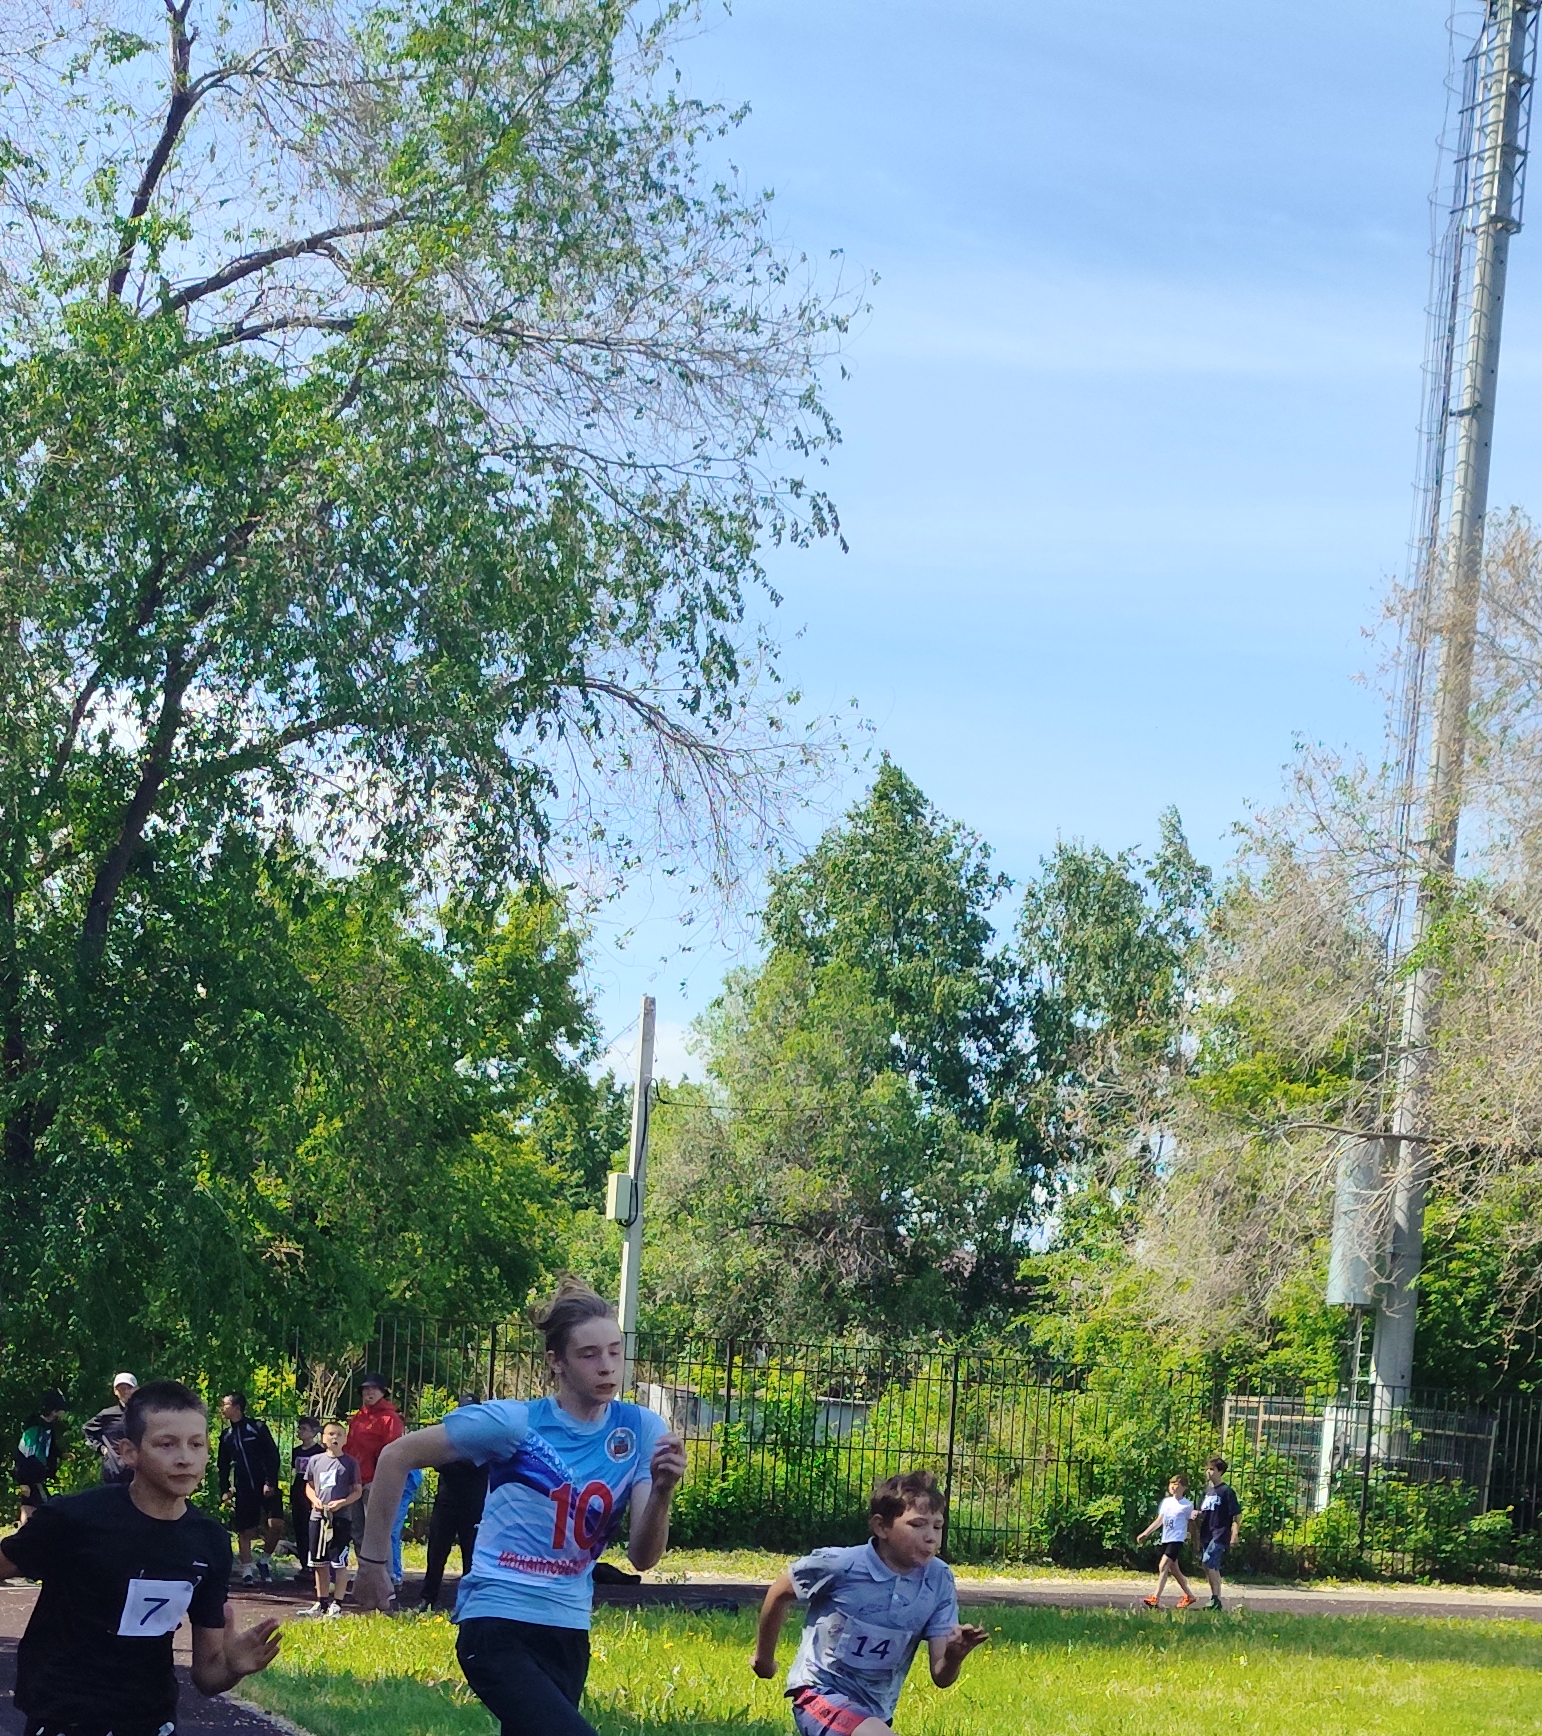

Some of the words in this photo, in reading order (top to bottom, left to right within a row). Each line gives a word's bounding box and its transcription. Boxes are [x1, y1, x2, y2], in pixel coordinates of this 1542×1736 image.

[551, 1481, 613, 1550] 10
[140, 1598, 170, 1626] 7
[851, 1636, 891, 1660] 14
